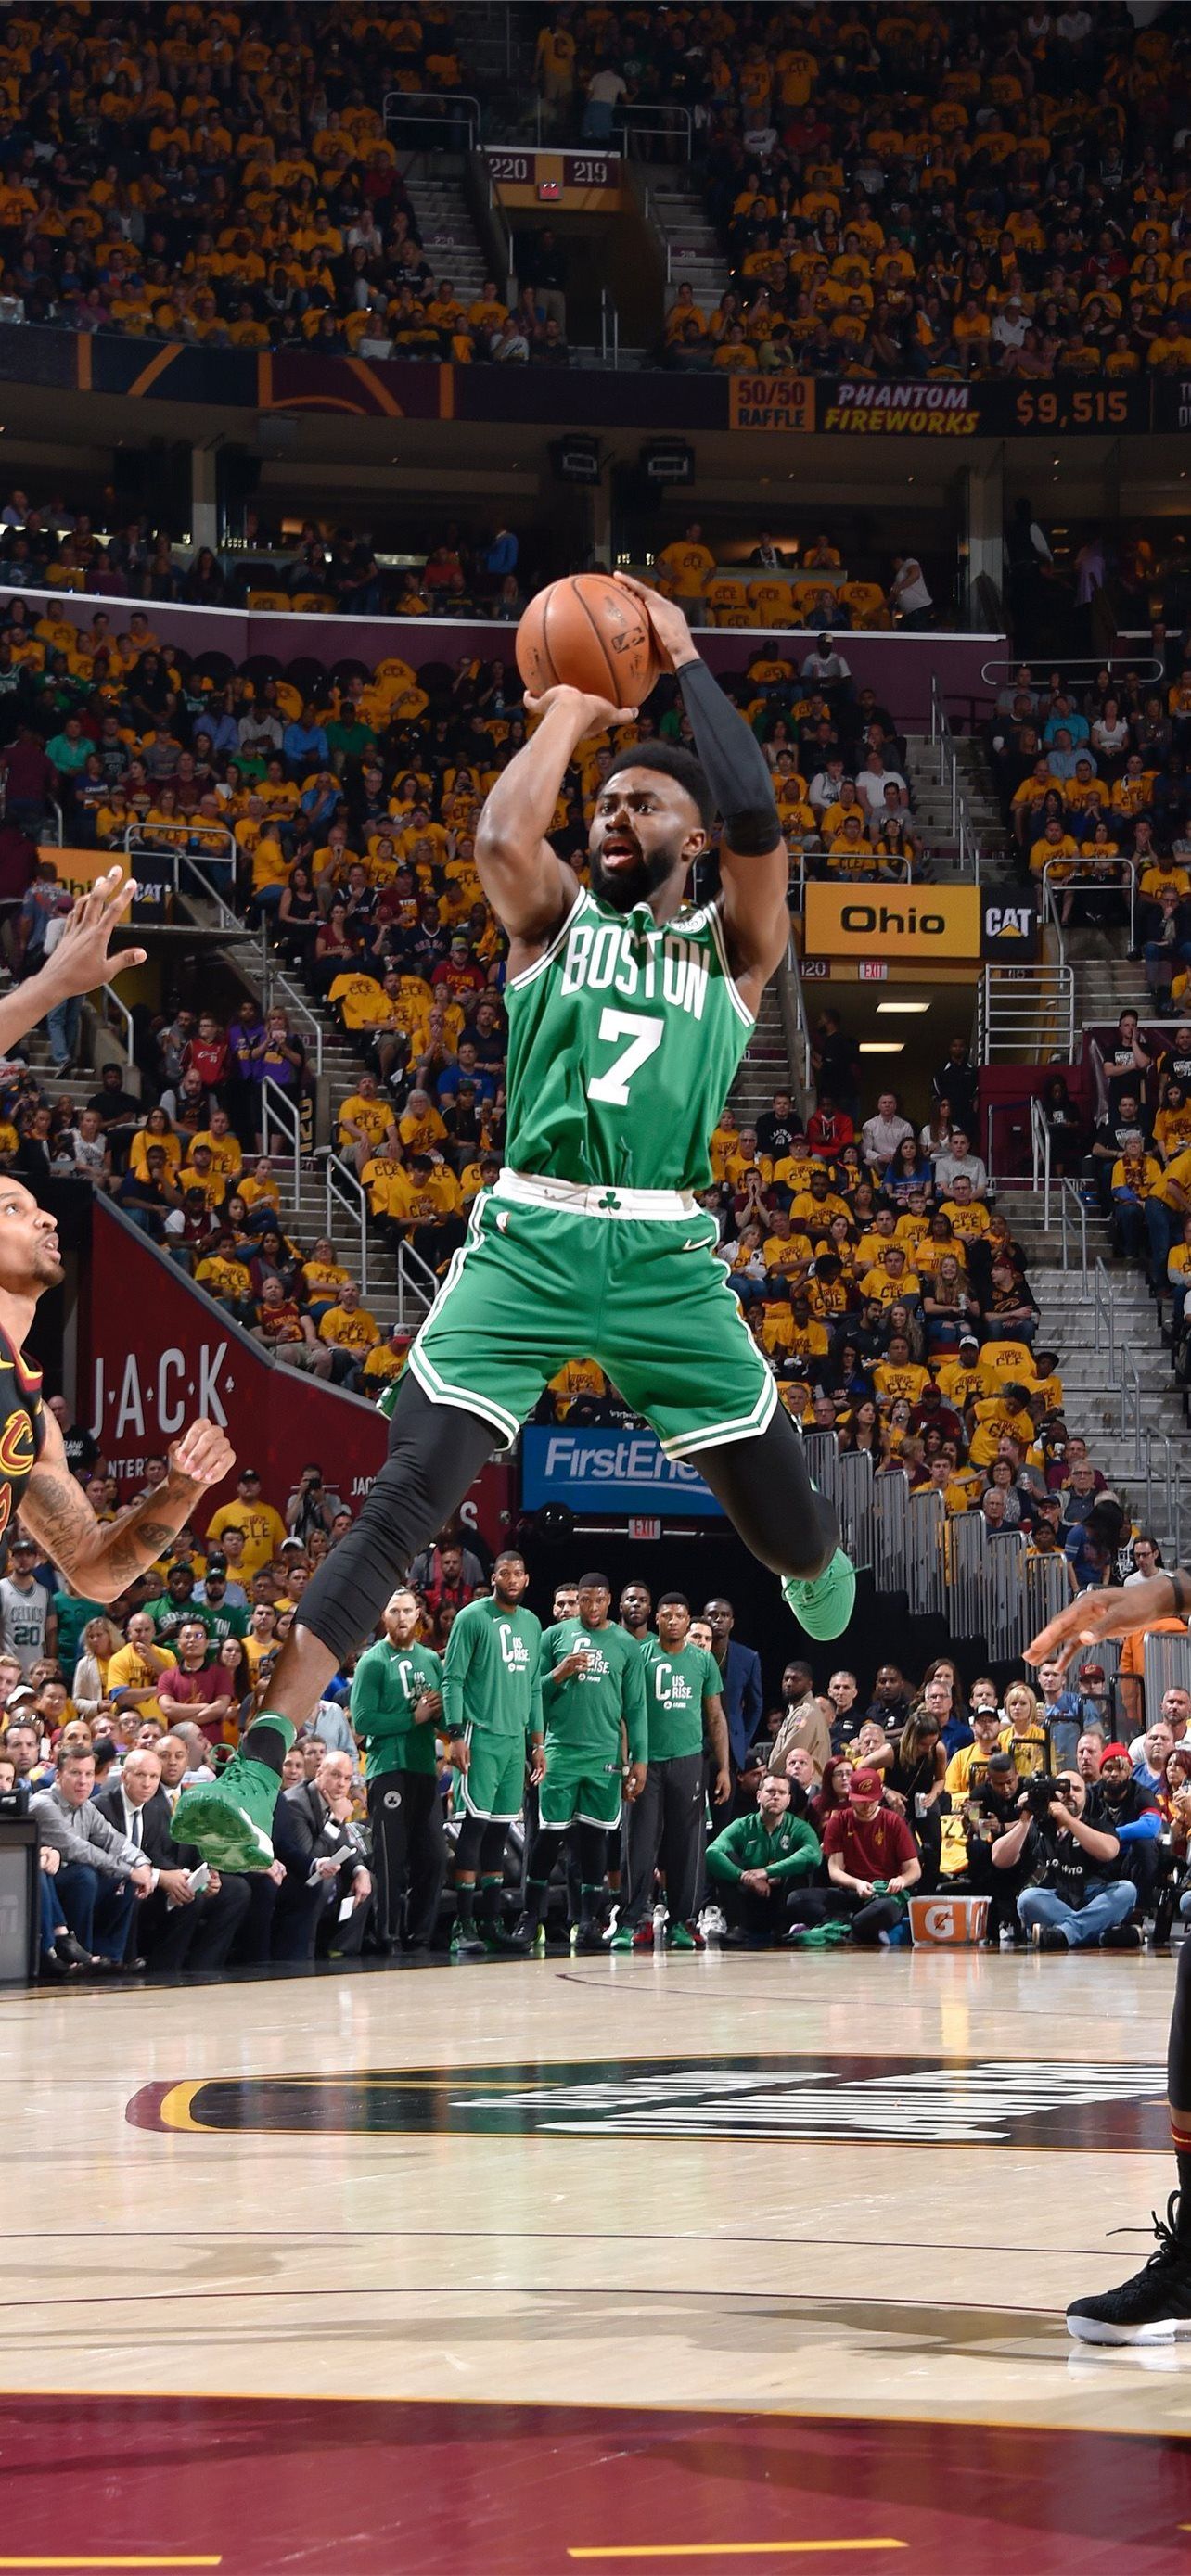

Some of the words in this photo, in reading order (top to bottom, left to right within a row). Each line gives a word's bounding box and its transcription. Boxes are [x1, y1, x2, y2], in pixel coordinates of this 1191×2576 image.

[489, 158, 527, 179] 220
[573, 161, 607, 183] 219
[737, 380, 805, 405] 50/50
[838, 384, 970, 409] PHANTOM
[738, 408, 805, 429] RAFFLE
[1017, 390, 1128, 427] $9,515
[825, 407, 980, 434] FIREWORKS
[134, 883, 162, 902] CAT
[840, 906, 946, 935] Ohio
[985, 907, 1031, 937] CAT
[561, 925, 711, 1021] BOSTON
[801, 961, 826, 976] 120
[864, 963, 882, 978] EXIT
[349, 983, 375, 996] CLE
[586, 1007, 665, 1106] 7
[354, 1116, 382, 1129] CLE
[374, 1165, 399, 1178] CLE
[952, 1218, 980, 1230] CLE
[218, 1274, 246, 1287] CLE
[881, 1286, 905, 1299] CLE
[338, 1329, 364, 1343] CLE
[887, 1382, 913, 1395] CLE
[955, 1383, 983, 1397] CLE
[351, 1476, 378, 1496] JAC
[634, 1520, 655, 1537] EXIT
[11, 1605, 45, 1625] CELTICS
[14, 1626, 39, 1646] 20
[672, 1675, 685, 1688] US
[924, 1904, 954, 1939] G
